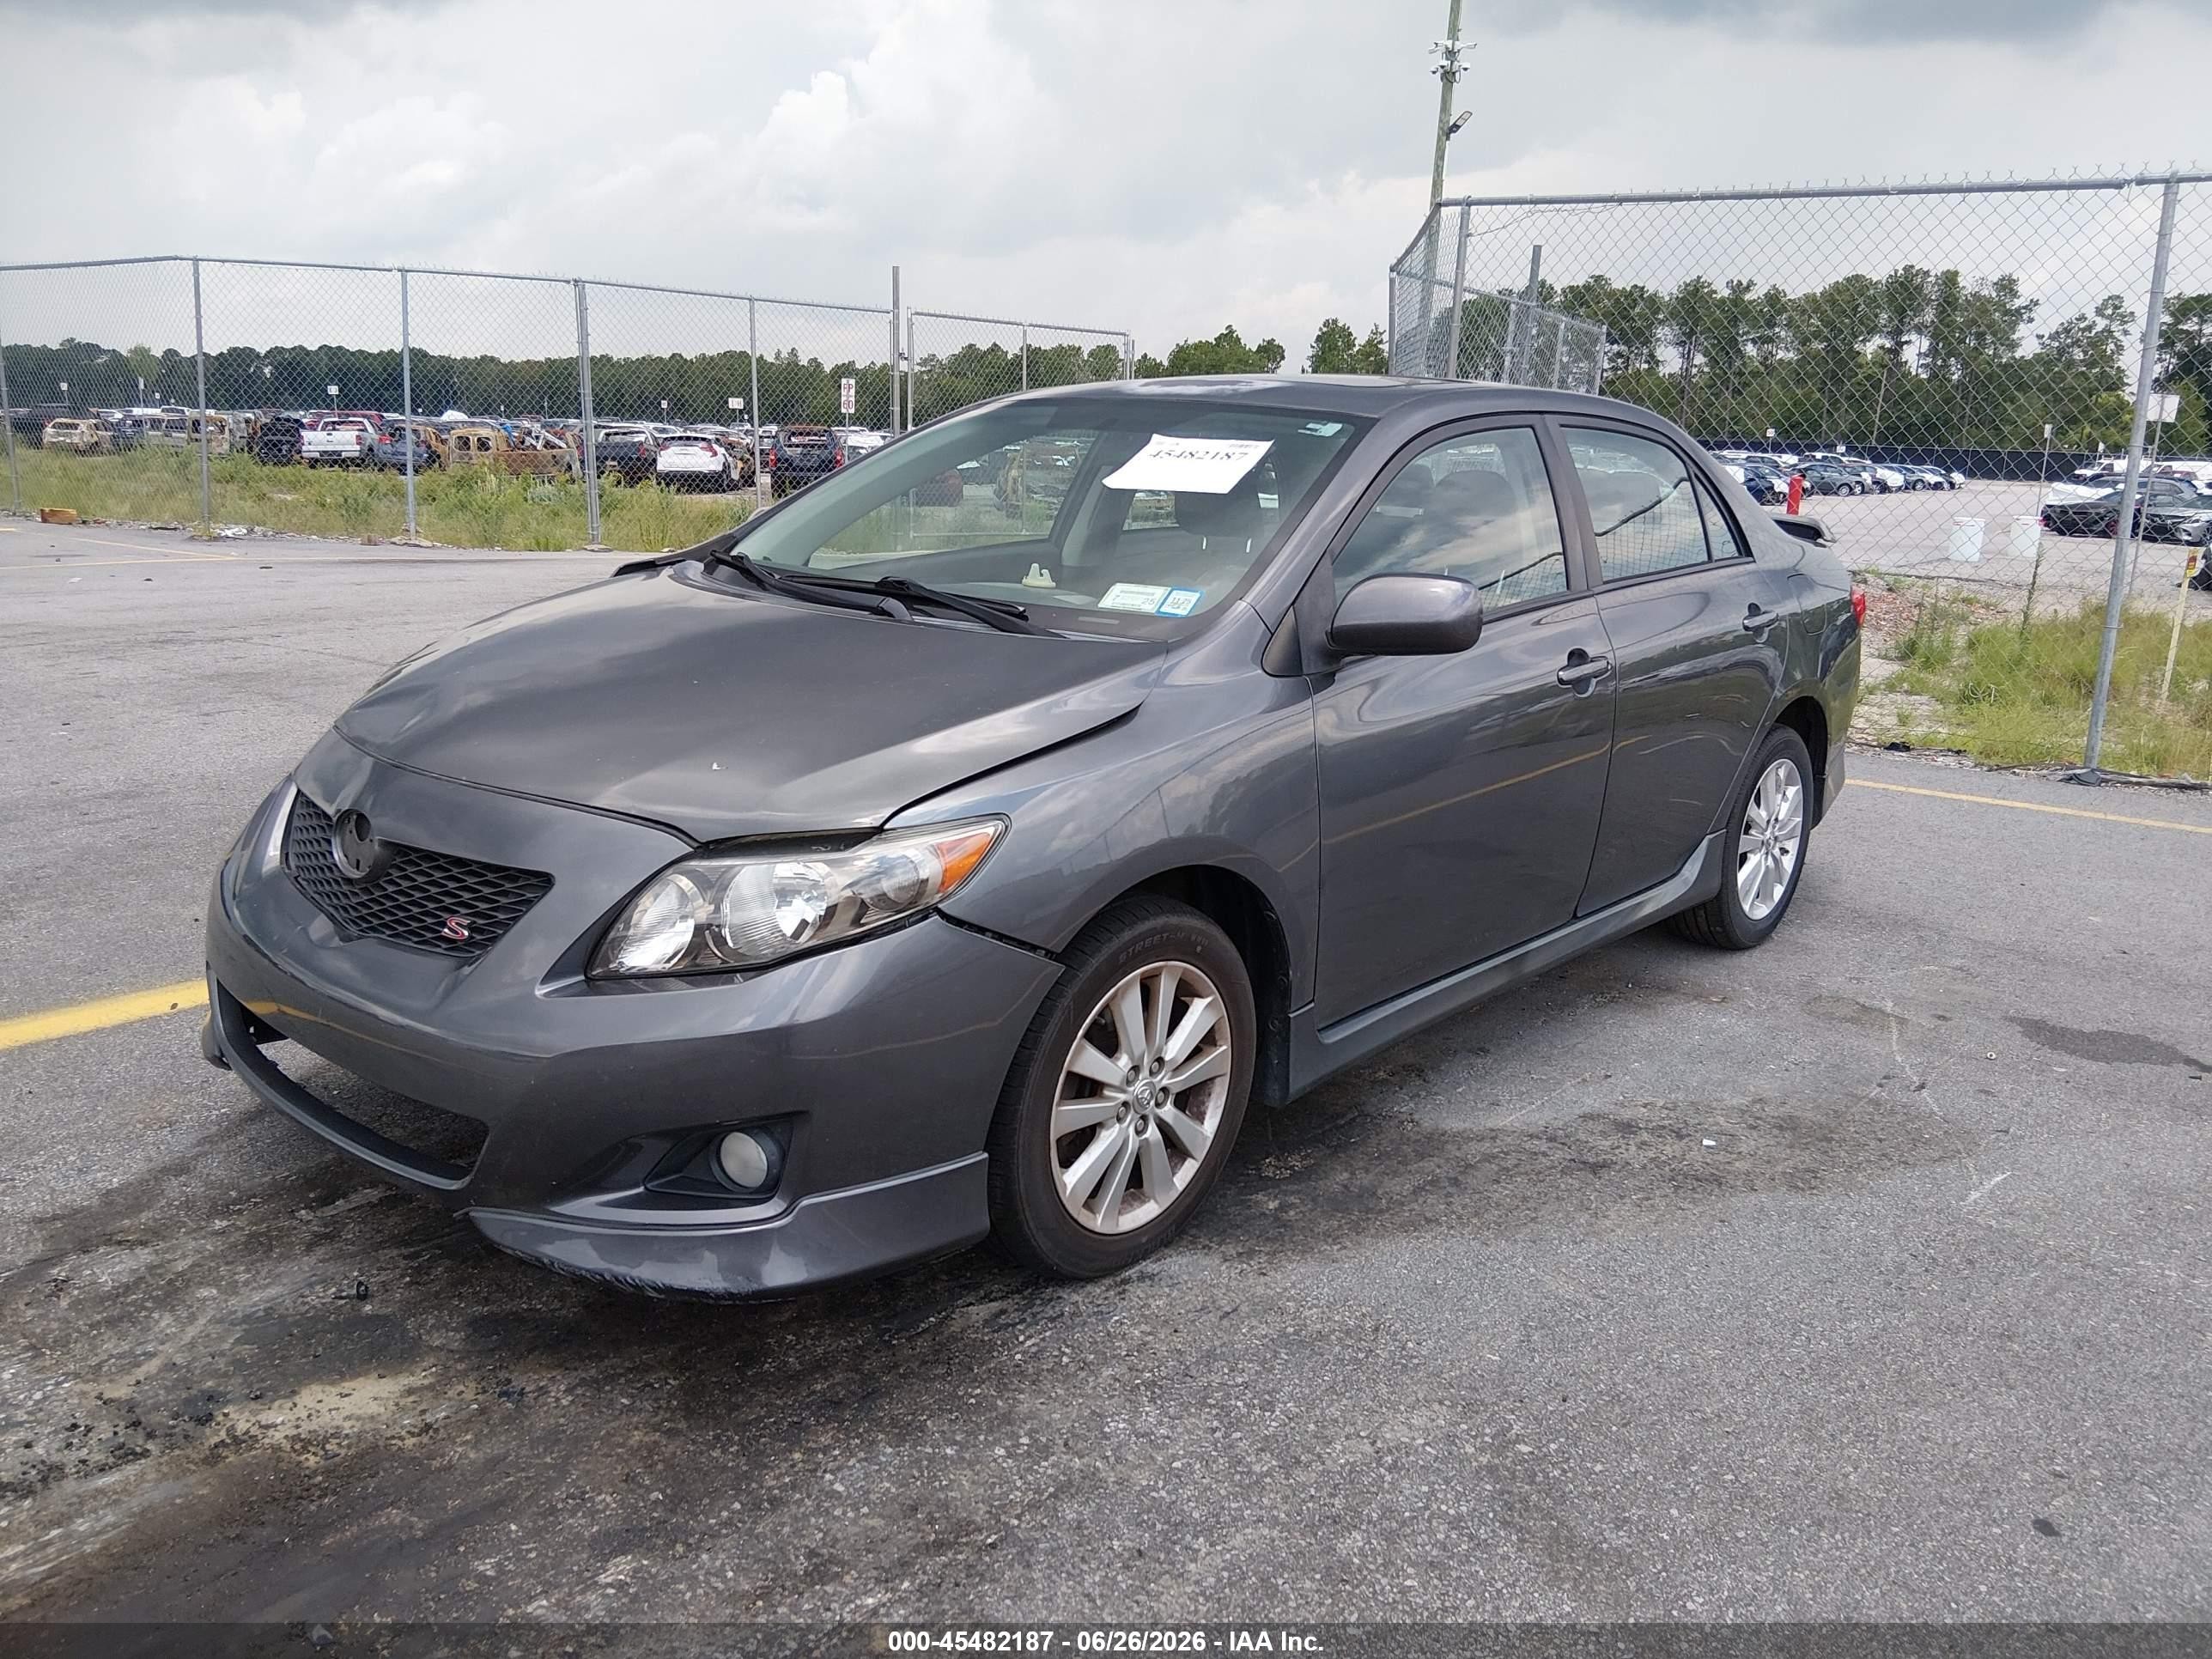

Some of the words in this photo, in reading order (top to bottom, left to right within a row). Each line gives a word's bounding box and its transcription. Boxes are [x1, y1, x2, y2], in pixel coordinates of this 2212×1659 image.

[842, 399, 854, 410] 60
[1148, 449, 1249, 461] 45482187
[441, 916, 471, 940] S
